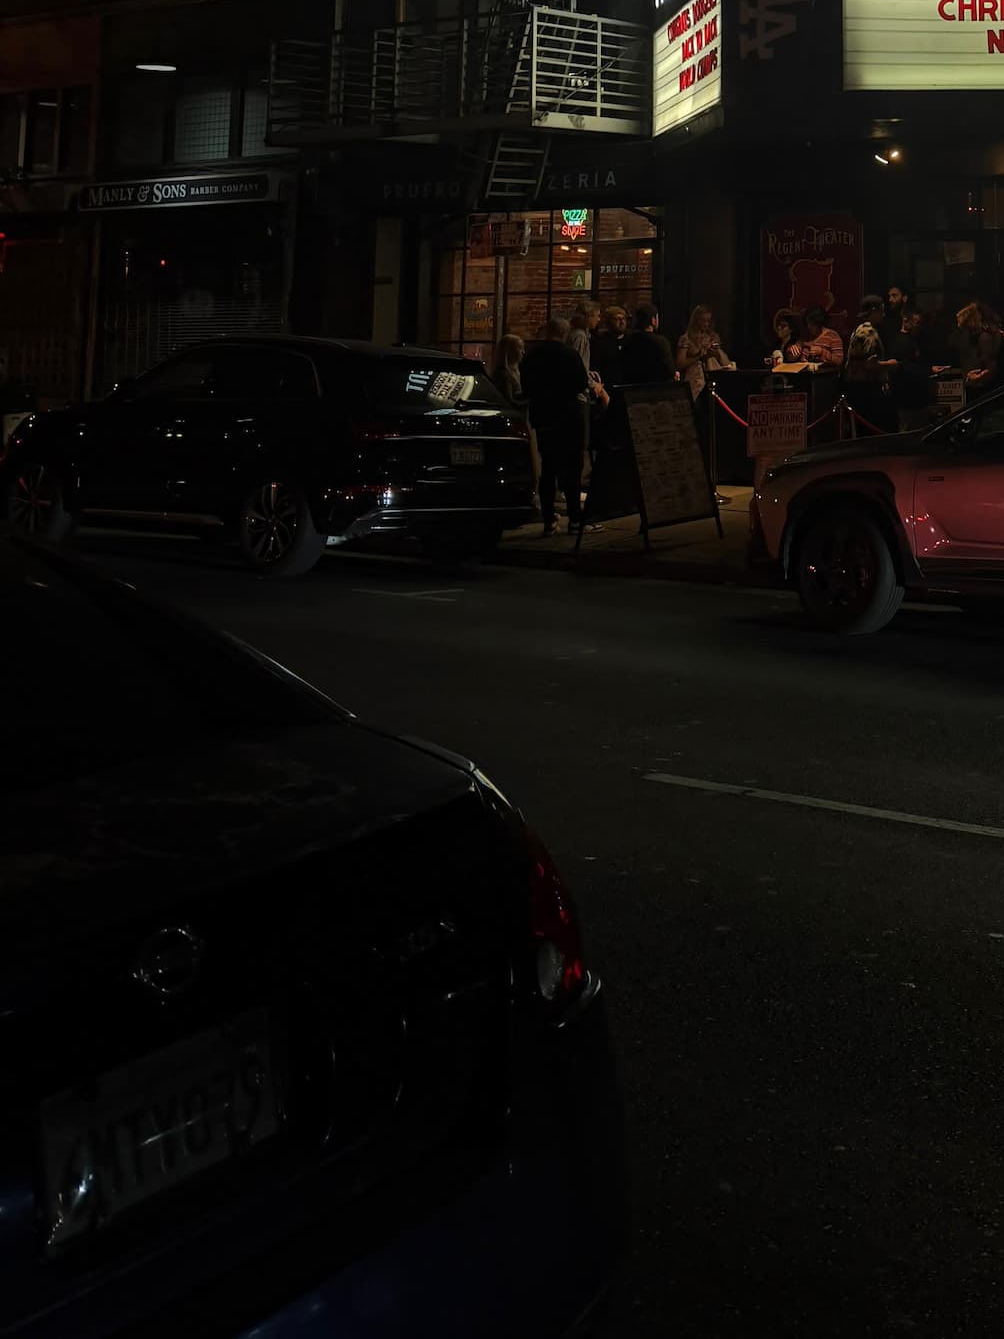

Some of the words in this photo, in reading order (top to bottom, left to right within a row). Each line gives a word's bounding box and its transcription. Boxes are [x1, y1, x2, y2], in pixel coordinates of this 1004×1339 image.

[88, 187, 133, 207] MANLY
[137, 185, 150, 203] &
[152, 183, 187, 203] SONS
[190, 185, 219, 196] BARBER
[562, 208, 588, 221] PIZZA
[752, 412, 768, 424] NO
